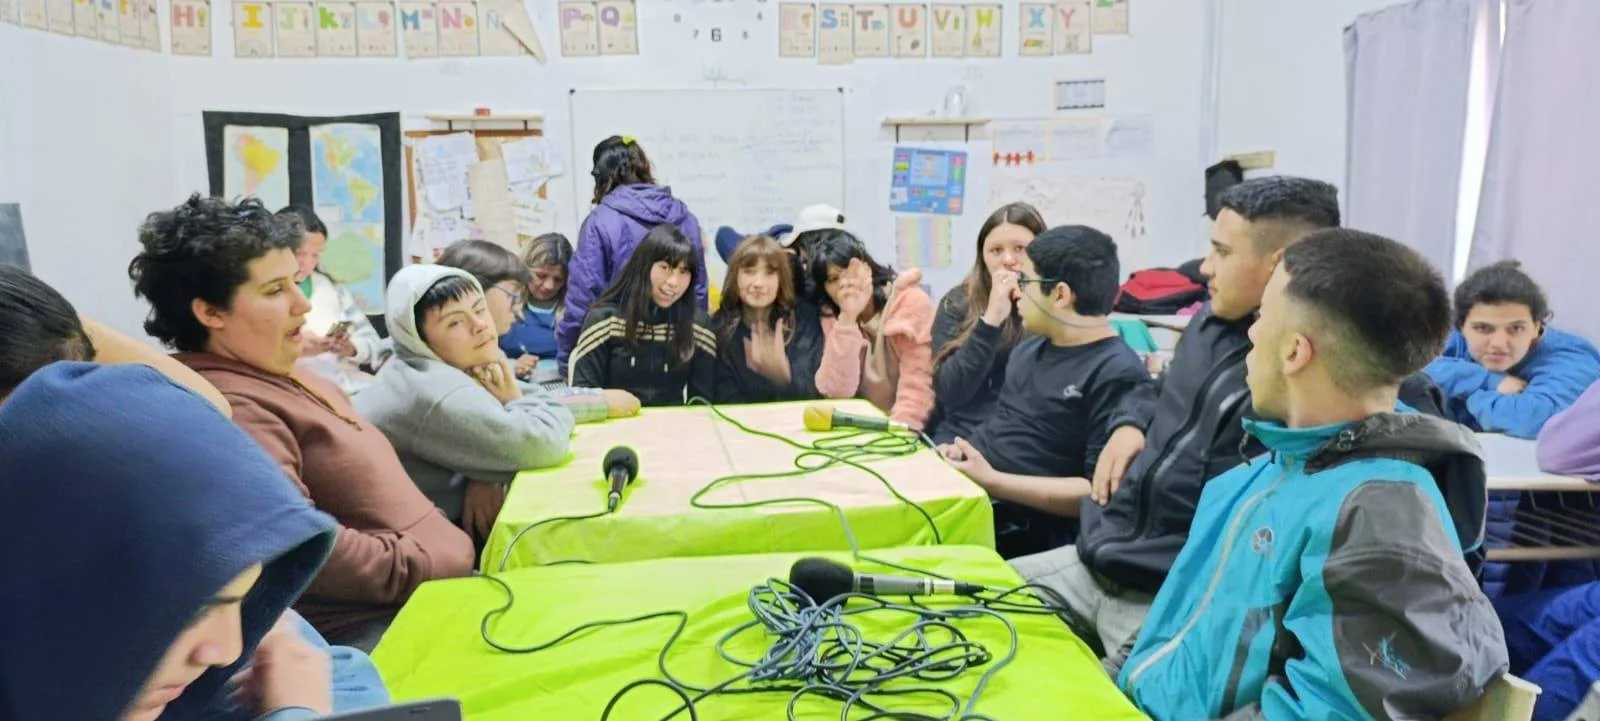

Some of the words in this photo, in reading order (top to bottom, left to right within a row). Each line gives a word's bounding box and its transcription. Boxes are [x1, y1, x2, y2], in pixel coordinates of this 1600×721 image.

[174, 4, 195, 28] H
[241, 4, 263, 29] I
[401, 8, 420, 31] M
[441, 7, 462, 30] N
[562, 8, 582, 29] P
[600, 6, 620, 28] Q
[820, 8, 838, 29] S
[856, 10, 874, 31] T
[898, 8, 918, 28] U
[933, 9, 951, 31] V
[976, 8, 994, 28] W
[1028, 8, 1045, 28] X
[1059, 8, 1076, 30] Y
[711, 28, 721, 42] 6
